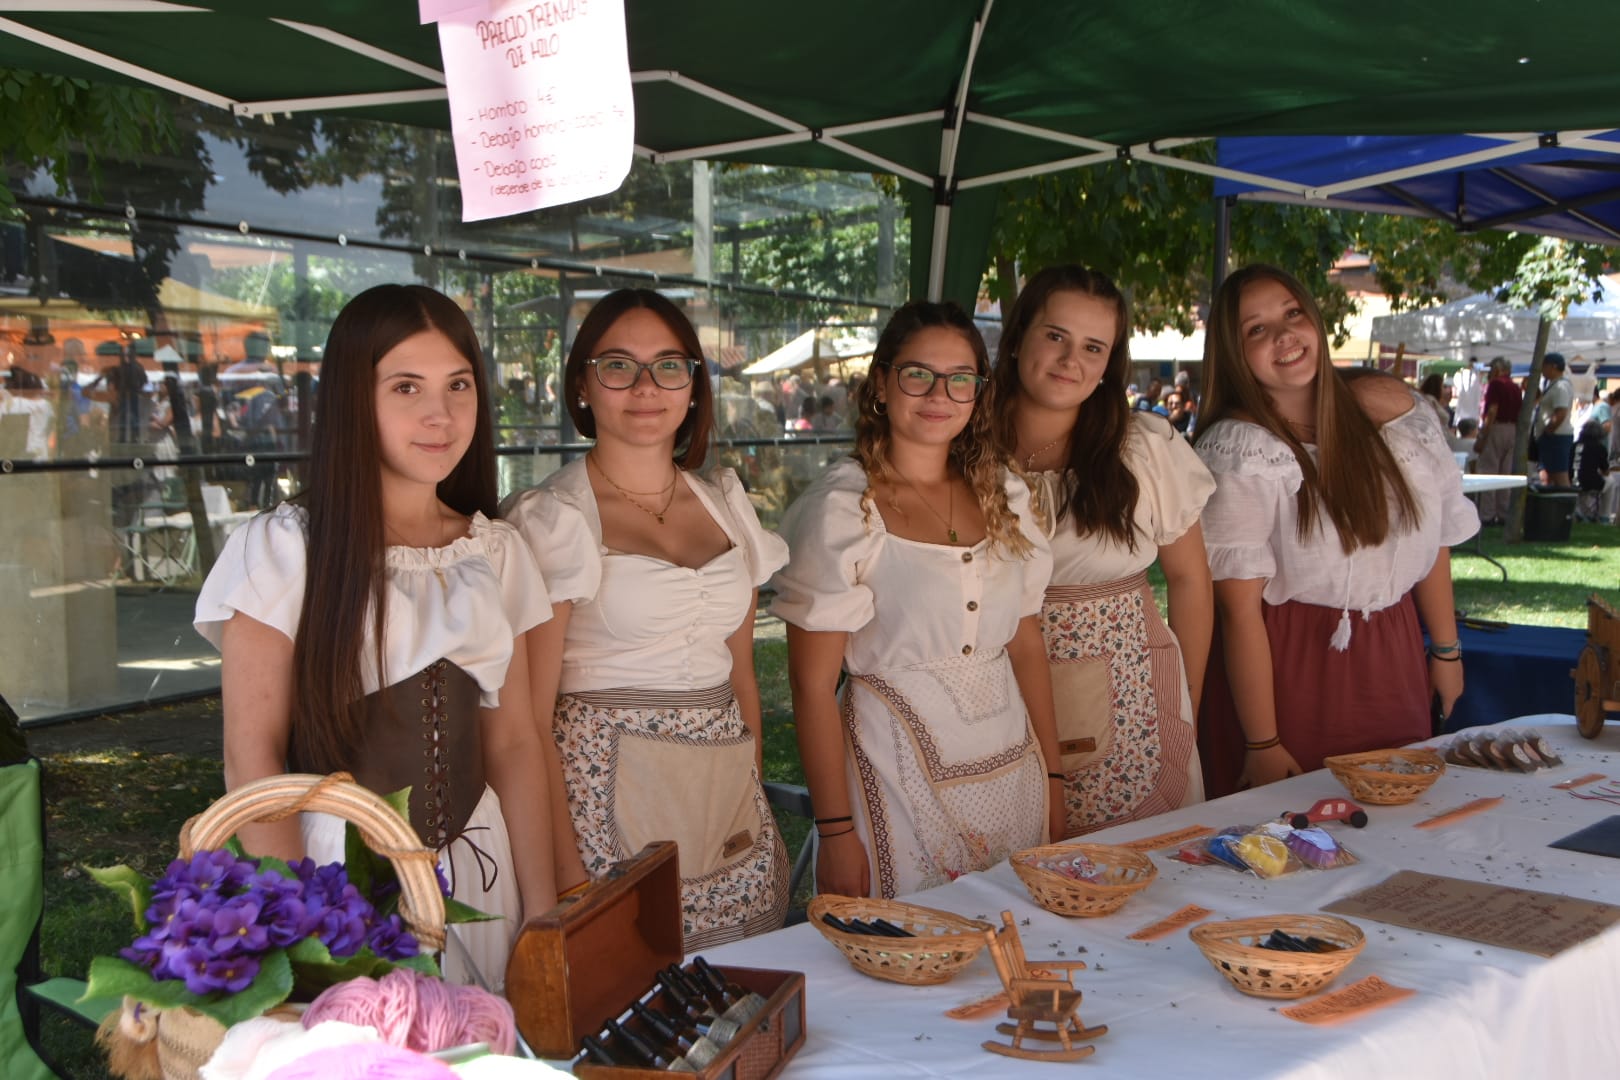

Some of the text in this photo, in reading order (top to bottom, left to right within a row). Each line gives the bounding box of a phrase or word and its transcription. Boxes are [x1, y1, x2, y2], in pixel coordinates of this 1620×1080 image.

[476, 14, 527, 50] PRECIO
[505, 33, 560, 69] DE HILO
[478, 99, 528, 122] Hombro
[480, 126, 522, 150] Debajo
[483, 160, 528, 178] Debajo
